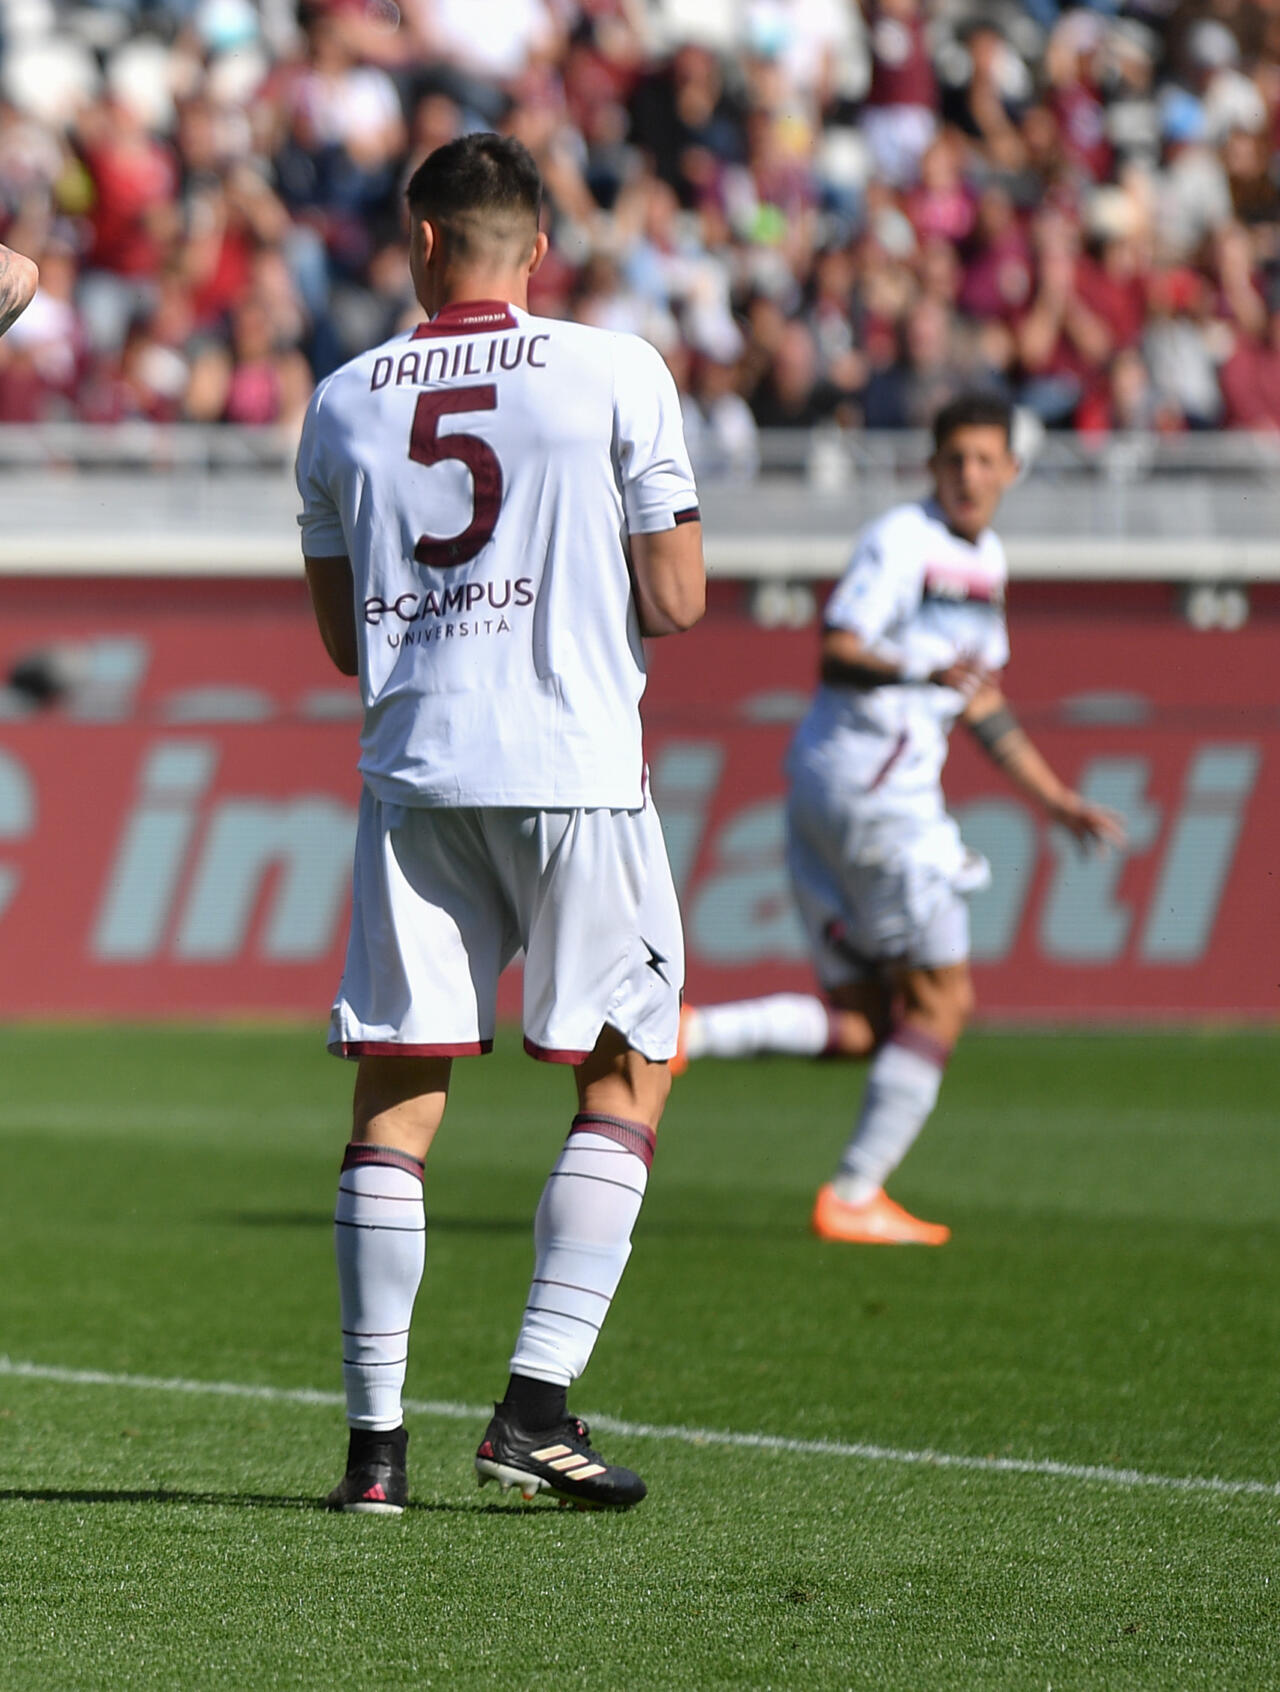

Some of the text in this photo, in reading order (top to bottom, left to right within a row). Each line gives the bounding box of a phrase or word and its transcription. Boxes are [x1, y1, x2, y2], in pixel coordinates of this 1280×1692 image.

[370, 335, 550, 391] DANILIUC
[408, 384, 503, 567] 5
[387, 615, 511, 649] UNIVERSITÀ
